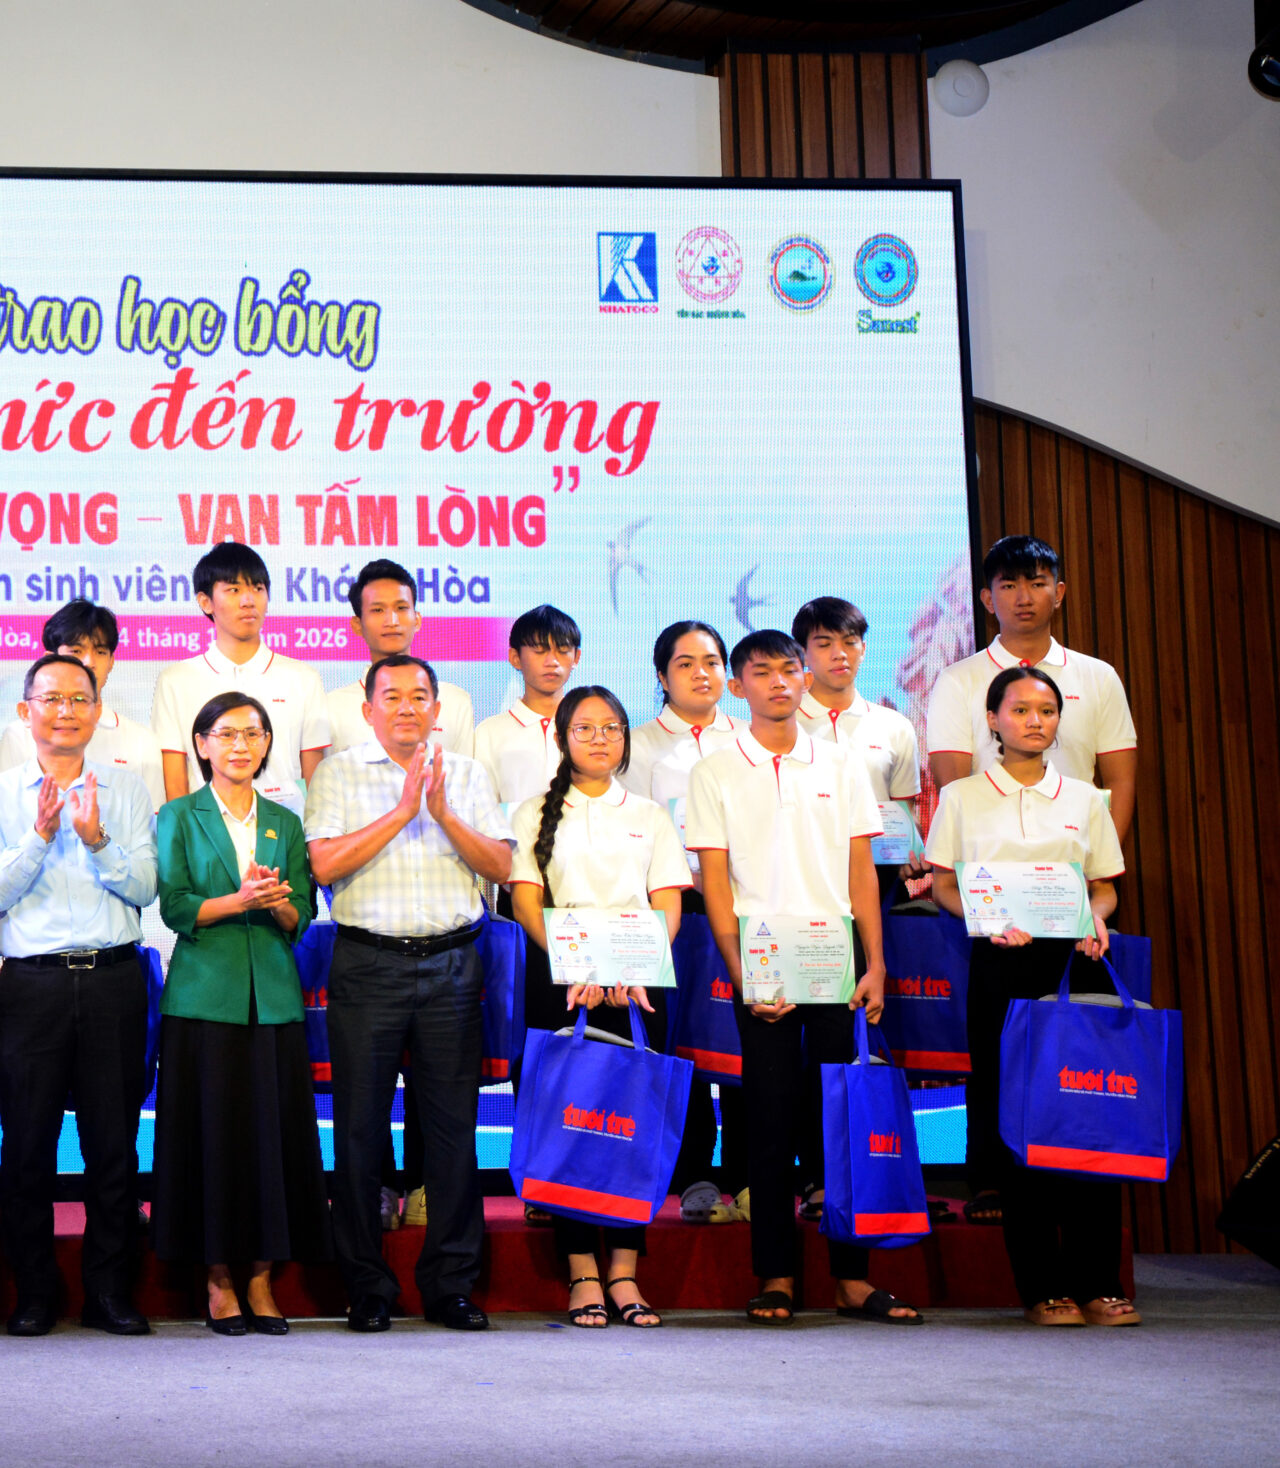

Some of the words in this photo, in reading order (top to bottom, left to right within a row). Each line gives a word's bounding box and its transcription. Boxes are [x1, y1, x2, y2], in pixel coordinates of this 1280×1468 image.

[116, 275, 226, 369] học
[233, 270, 381, 371] bổng
[599, 305, 659, 314] KHATOCO
[129, 367, 303, 451] đến
[333, 380, 661, 477] trường
[295, 477, 399, 547] TẤM
[25, 566, 100, 602] sinh
[112, 563, 190, 602] viên
[285, 564, 356, 604] Khá
[416, 564, 491, 604] Hòa
[137, 628, 201, 652] tháng
[295, 628, 348, 648] 2026
